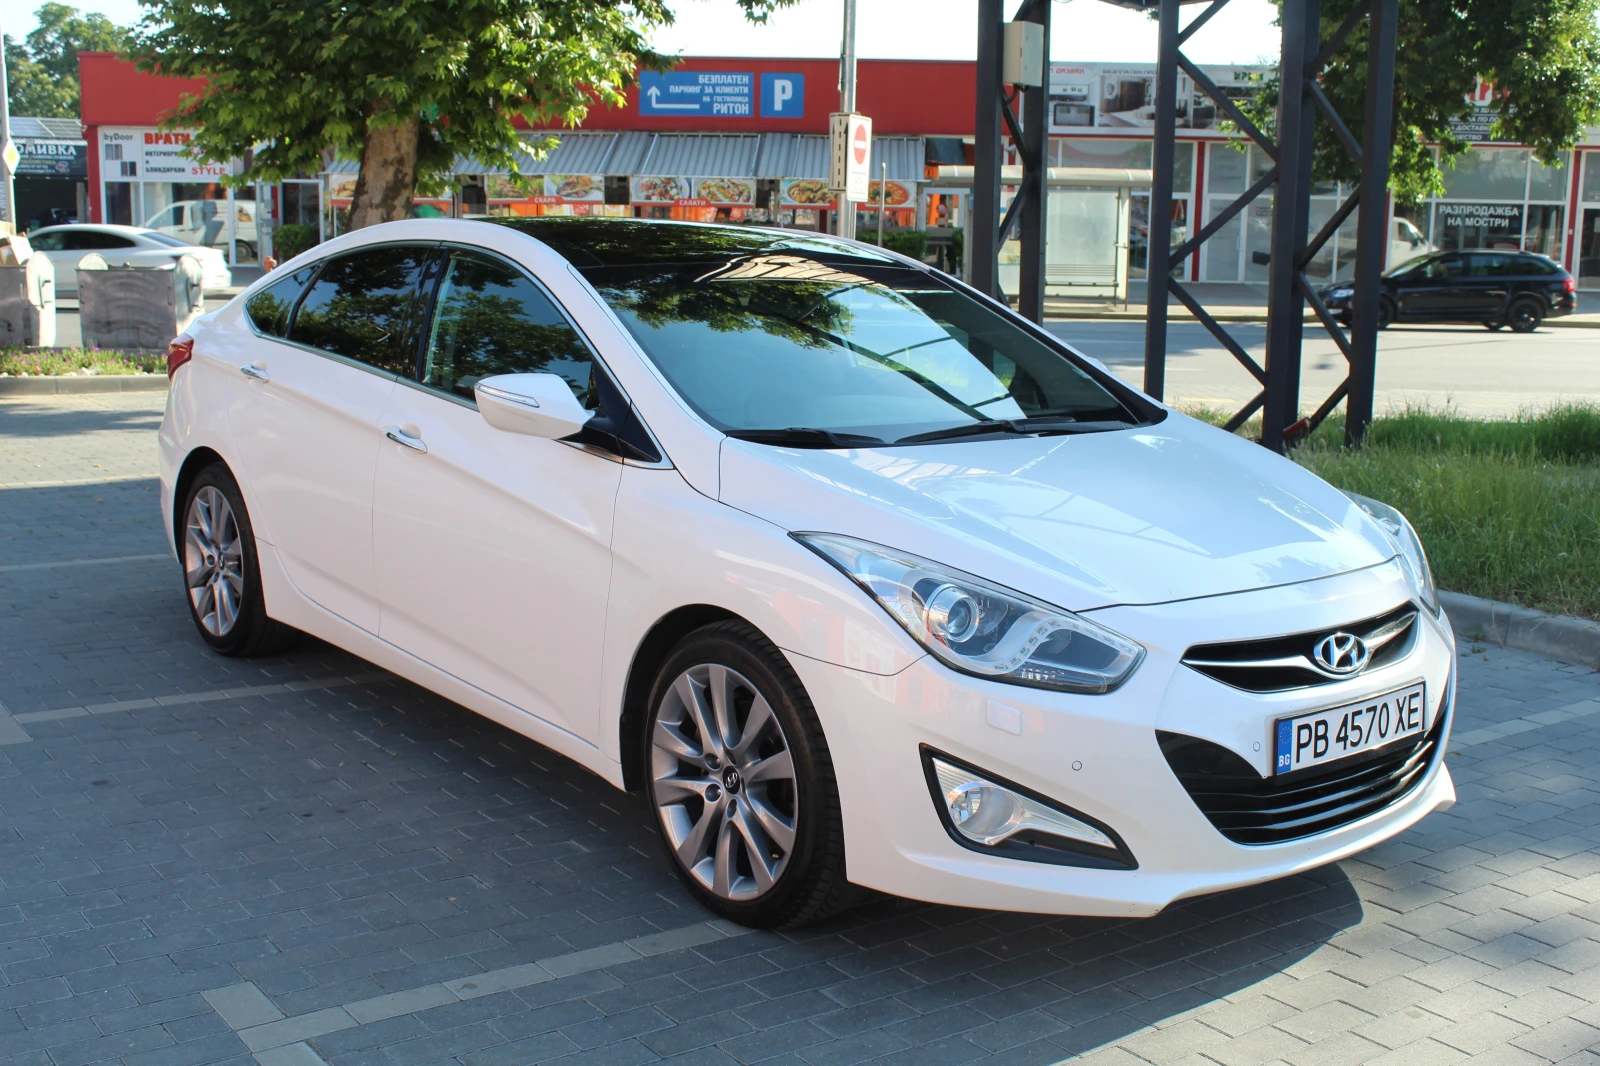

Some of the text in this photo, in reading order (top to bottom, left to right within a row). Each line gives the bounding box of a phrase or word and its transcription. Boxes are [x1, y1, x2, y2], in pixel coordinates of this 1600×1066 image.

[698, 74, 749, 85] БЕЗПЛАТЕН
[669, 85, 749, 94] ПАРКИНГ ЗА КЛИЕНТИ
[773, 79, 793, 111] P
[713, 103, 749, 115] РИТОН
[104, 133, 134, 142] byDoor
[144, 133, 190, 145] ВРАТИ
[191, 167, 226, 175] STYLE
[1439, 205, 1520, 216] РАЗПРОДАЖБА
[1447, 217, 1510, 228] НА МОСТРИ
[1295, 691, 1420, 763] PB 4570 XE
[1278, 753, 1291, 768] BG
